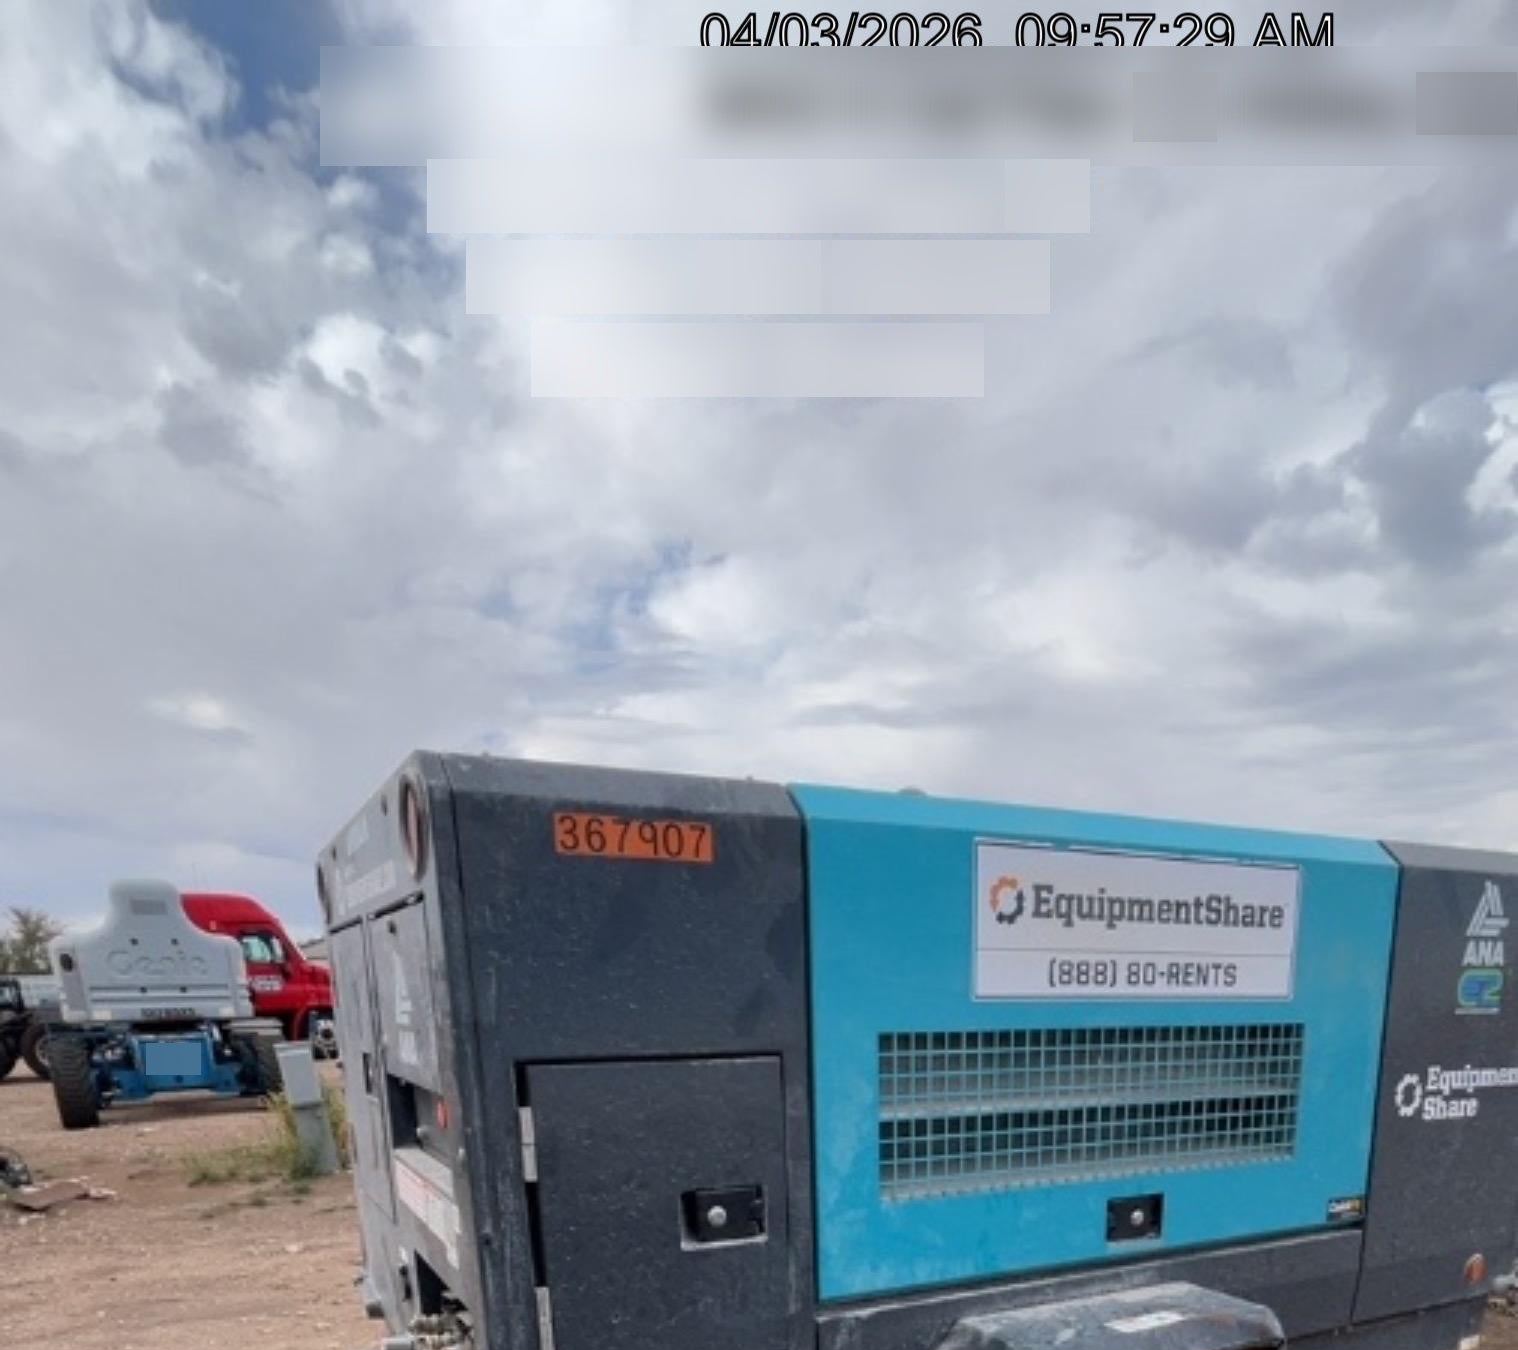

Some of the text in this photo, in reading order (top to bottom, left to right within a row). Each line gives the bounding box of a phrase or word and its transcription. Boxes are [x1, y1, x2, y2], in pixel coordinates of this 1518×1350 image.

[558, 815, 706, 858] 367907
[1031, 883, 1284, 930] EquipmentShare
[1461, 940, 1504, 967] ANA
[1049, 957, 1237, 988] (888) 80-RENTS
[1421, 1096, 1478, 1120] Share
